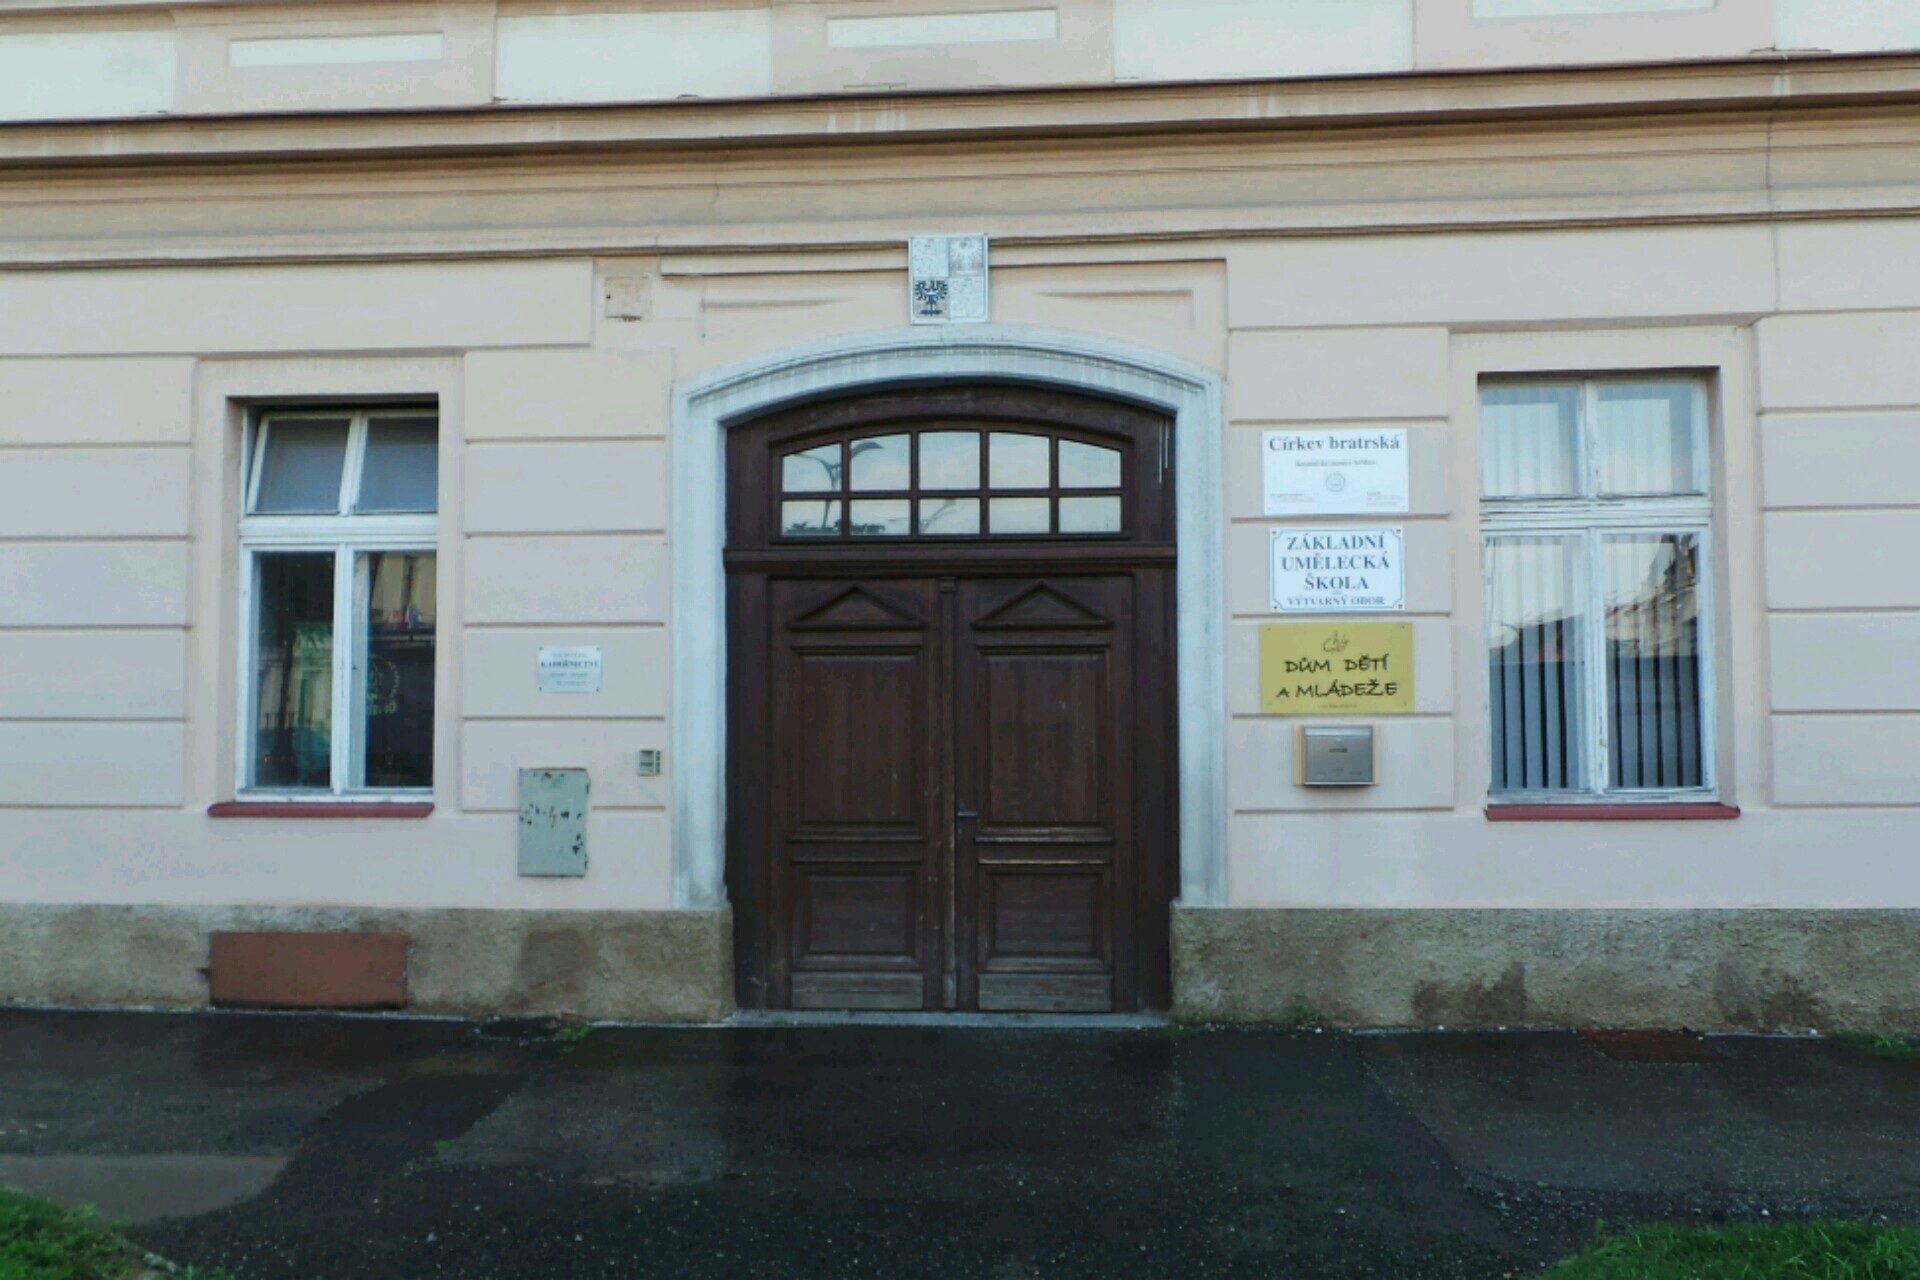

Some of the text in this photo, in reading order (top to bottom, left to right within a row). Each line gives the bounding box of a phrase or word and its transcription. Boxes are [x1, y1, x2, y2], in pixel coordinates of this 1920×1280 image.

[1269, 434, 1400, 451] Církev bratrská
[1287, 531, 1385, 551] ZÁKLADNÍ
[1281, 551, 1390, 571] UMĚLECKÁ
[1304, 573, 1370, 591] ŠKOLA
[1287, 595, 1385, 606] VÝTVARNÝ OBOR
[1284, 653, 1390, 674] DŮM DĚTÍ
[1276, 679, 1398, 698] A MLÁDEŽE
